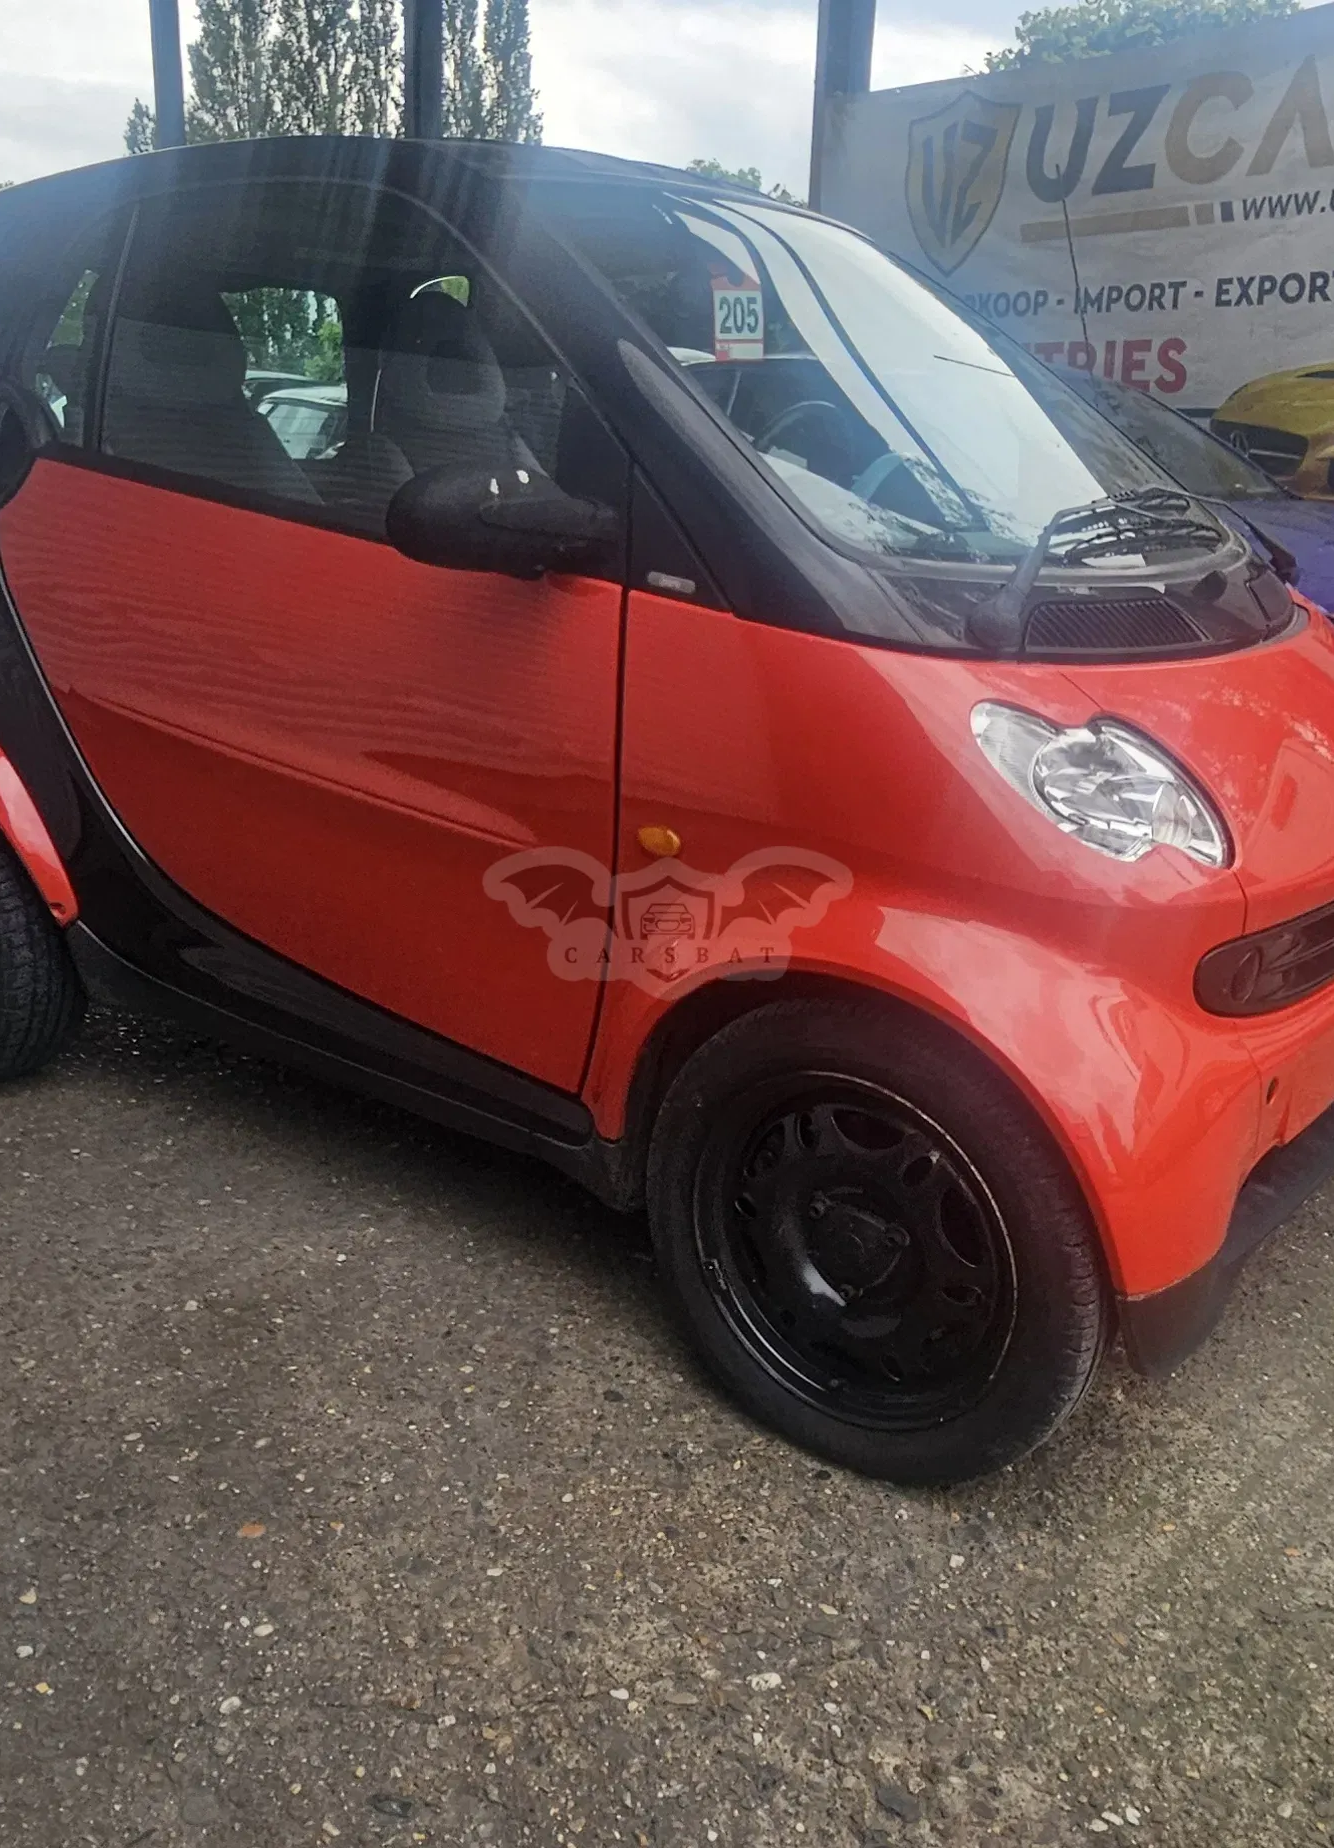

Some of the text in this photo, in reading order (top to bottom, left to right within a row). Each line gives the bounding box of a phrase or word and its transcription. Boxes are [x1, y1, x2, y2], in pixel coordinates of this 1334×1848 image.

[719, 296, 759, 334] 205
[1074, 281, 1188, 315] IMPORT
[1022, 337, 1188, 394] TRIES
